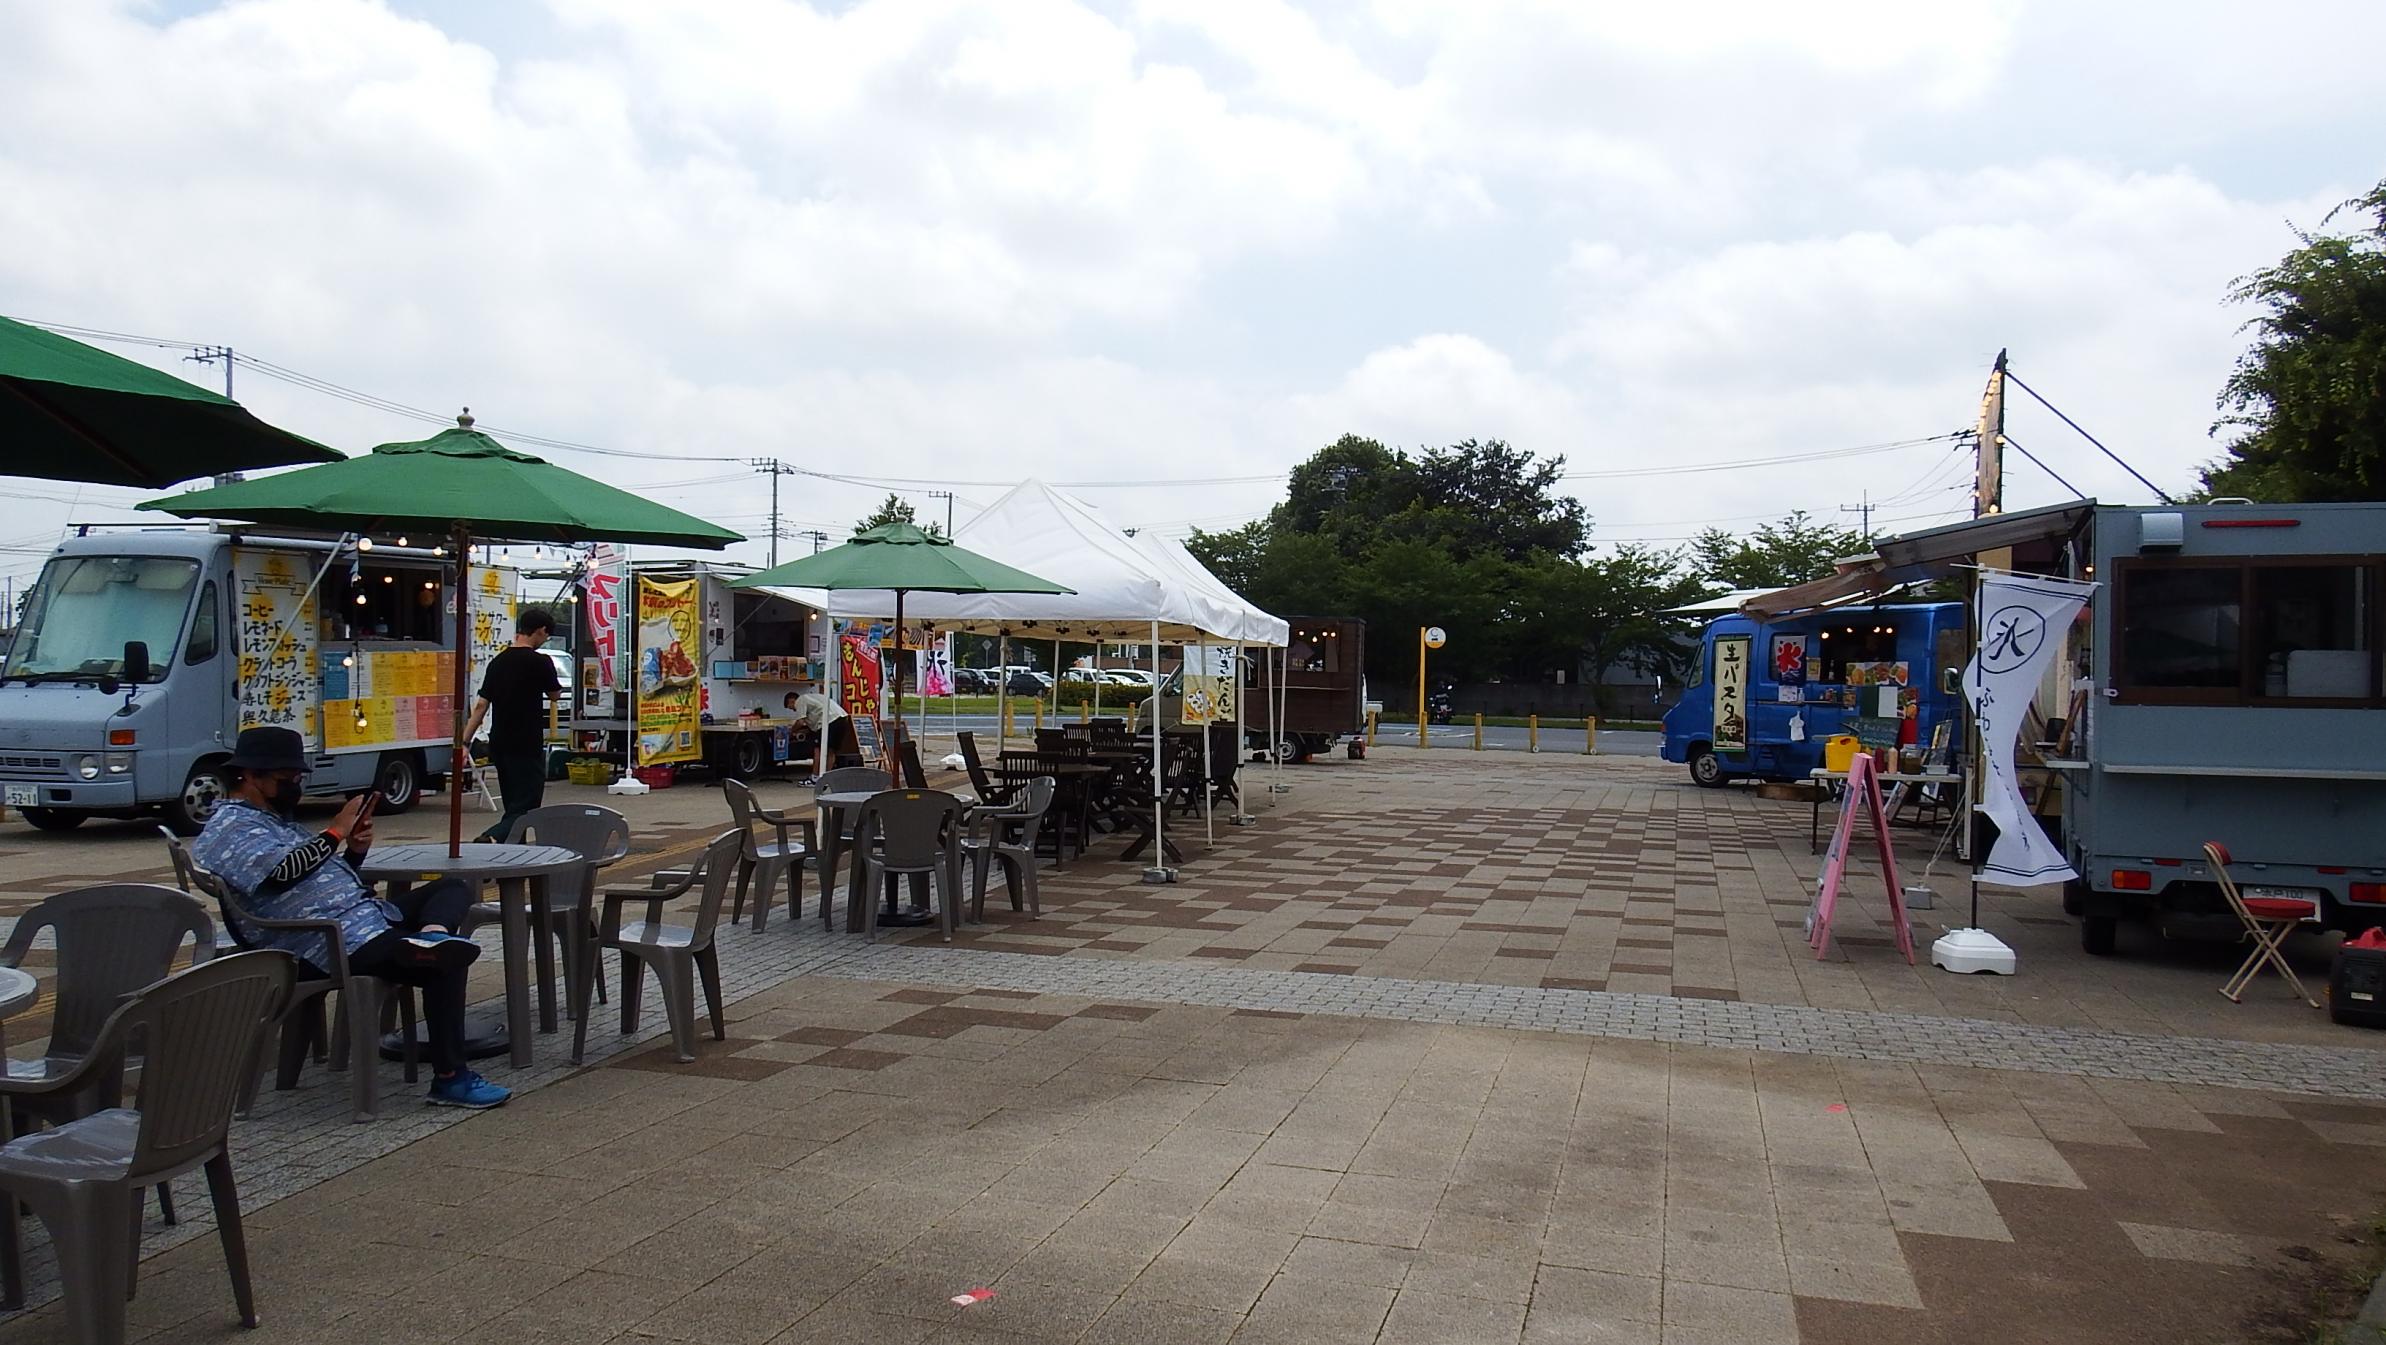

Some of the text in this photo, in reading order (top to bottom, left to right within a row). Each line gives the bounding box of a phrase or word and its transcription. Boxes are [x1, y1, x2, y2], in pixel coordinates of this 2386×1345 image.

[243, 603, 274, 617] コーヒー
[244, 620, 283, 635] レモネード
[1988, 616, 2034, 660] 氷
[1776, 642, 1802, 673] 氷
[1216, 645, 1236, 720] 焼きだんご
[1721, 643, 1740, 722] 生パスタ
[243, 688, 306, 706] 赤しそジュース
[11, 792, 37, 804] 52-11
